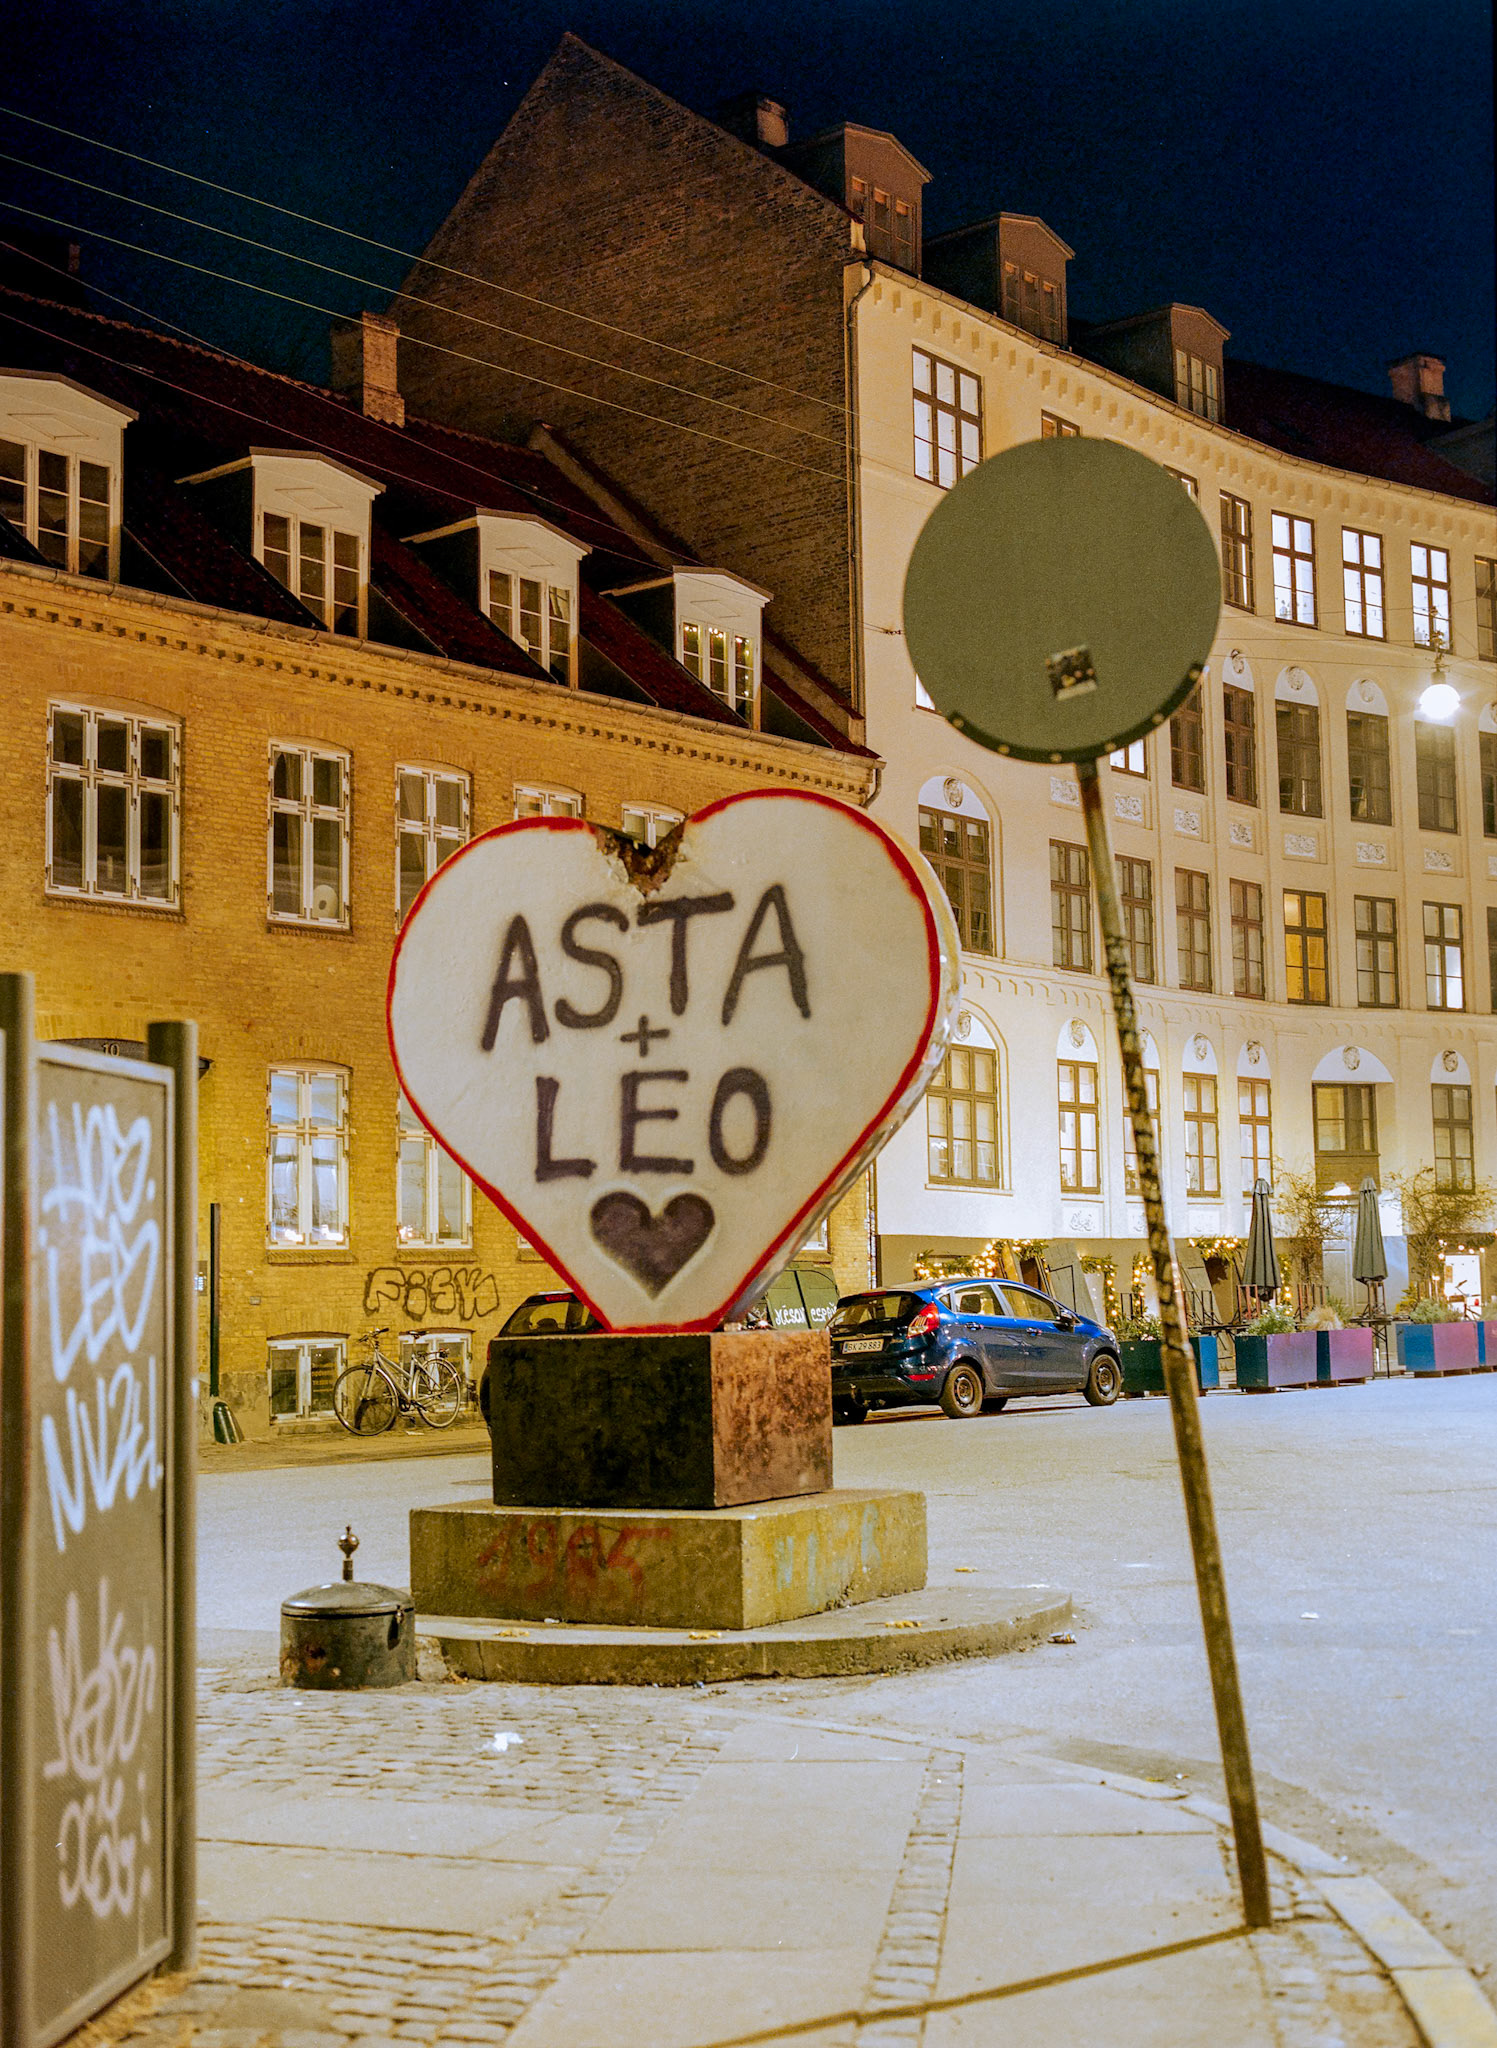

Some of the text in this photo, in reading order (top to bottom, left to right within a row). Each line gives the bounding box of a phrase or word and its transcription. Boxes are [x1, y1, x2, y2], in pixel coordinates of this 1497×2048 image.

[481, 884, 812, 1051] ASTA
[103, 1043, 120, 1056] 10
[620, 1015, 669, 1057] +
[536, 1067, 772, 1182] LEO
